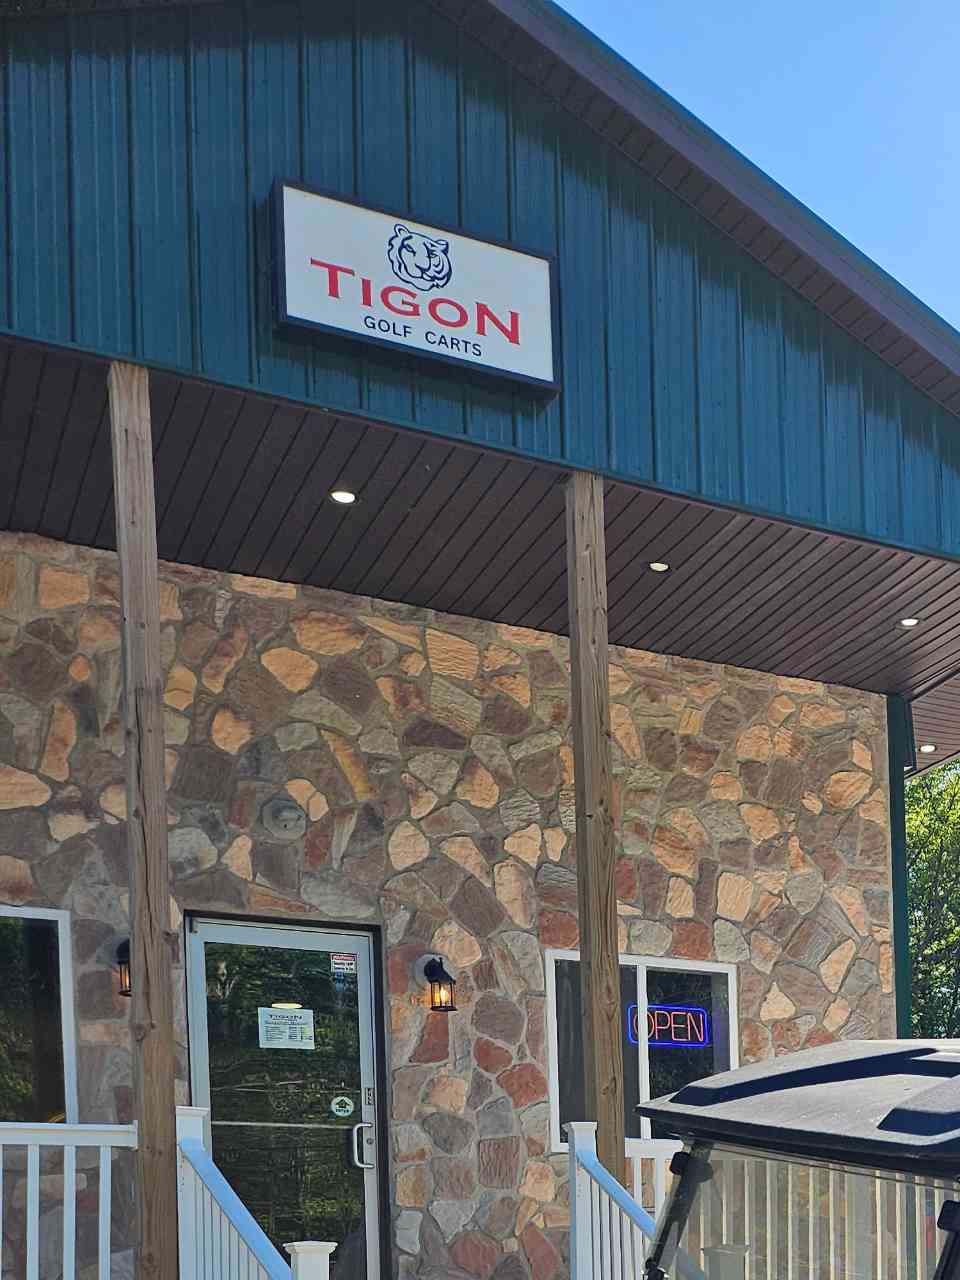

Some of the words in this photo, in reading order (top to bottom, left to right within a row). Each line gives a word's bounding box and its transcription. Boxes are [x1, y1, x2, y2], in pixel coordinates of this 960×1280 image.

[310, 258, 520, 345] TIGON
[364, 315, 412, 338] GOLF
[425, 331, 482, 356] CARTS
[633, 1010, 704, 1042] OPEN
